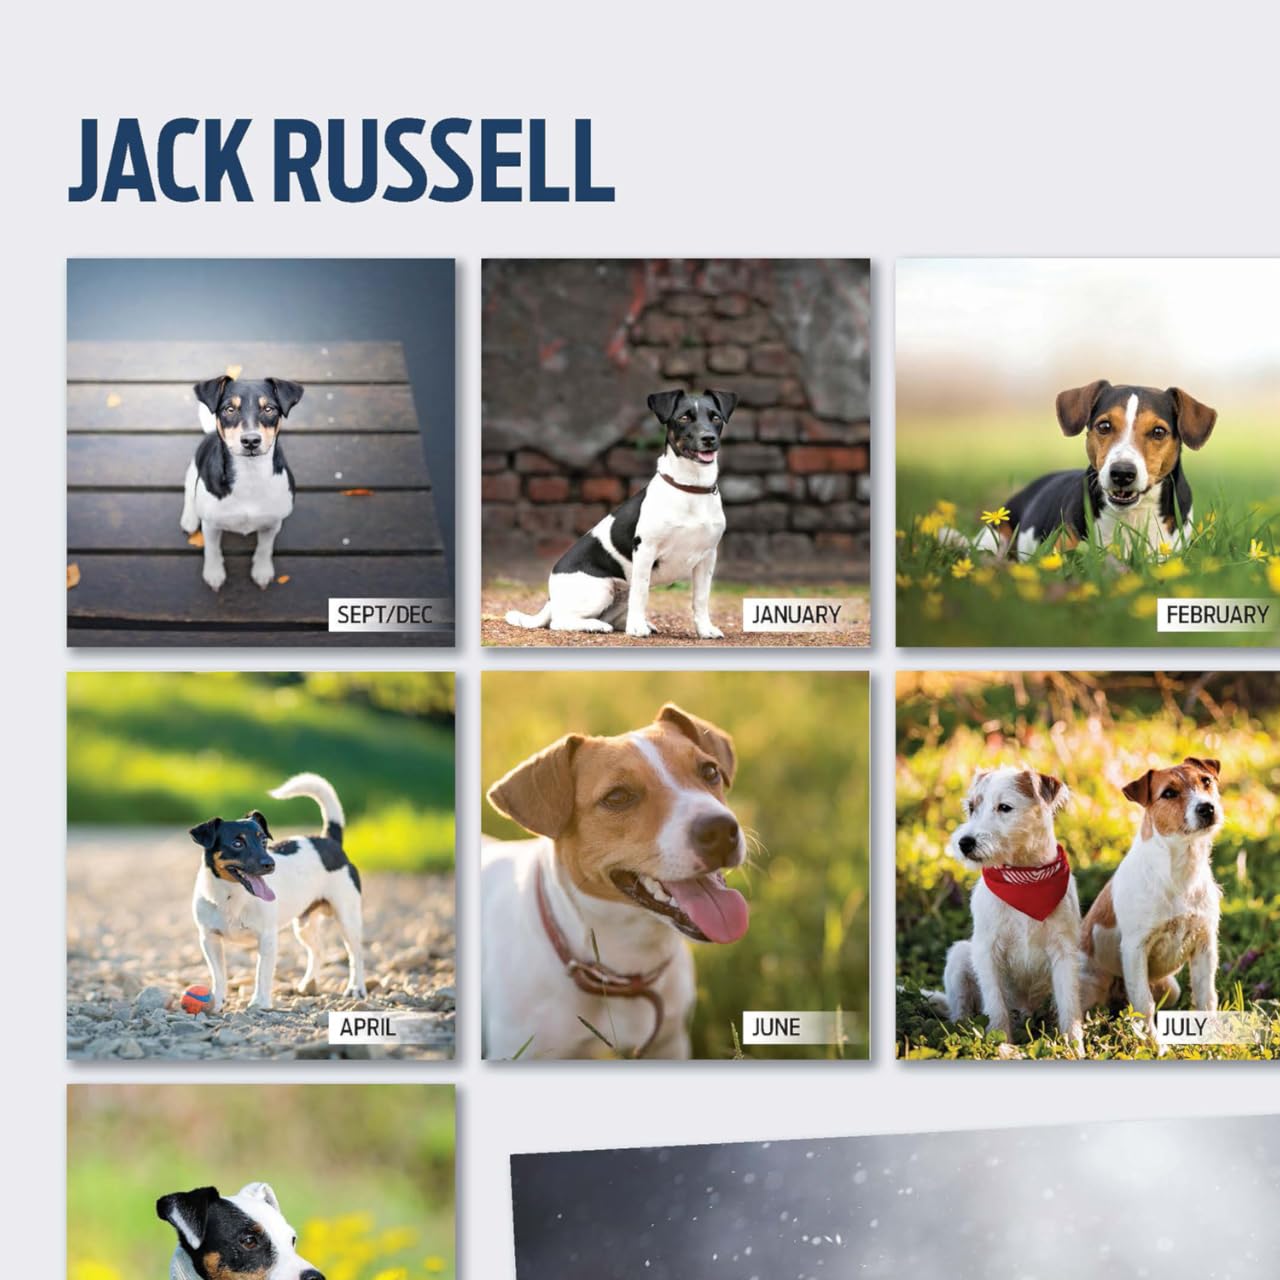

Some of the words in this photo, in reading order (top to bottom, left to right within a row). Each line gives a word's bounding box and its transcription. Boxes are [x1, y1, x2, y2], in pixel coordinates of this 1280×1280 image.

[68, 118, 254, 202] JACK
[274, 118, 615, 203] RUSSELL
[338, 605, 434, 624] SEPT/DEC
[753, 606, 841, 623] JANUARY
[1167, 605, 1270, 624] FEBRUARY
[340, 1018, 396, 1036] APRIL
[753, 1018, 800, 1036] JUNE
[1163, 1018, 1207, 1035] JULY
